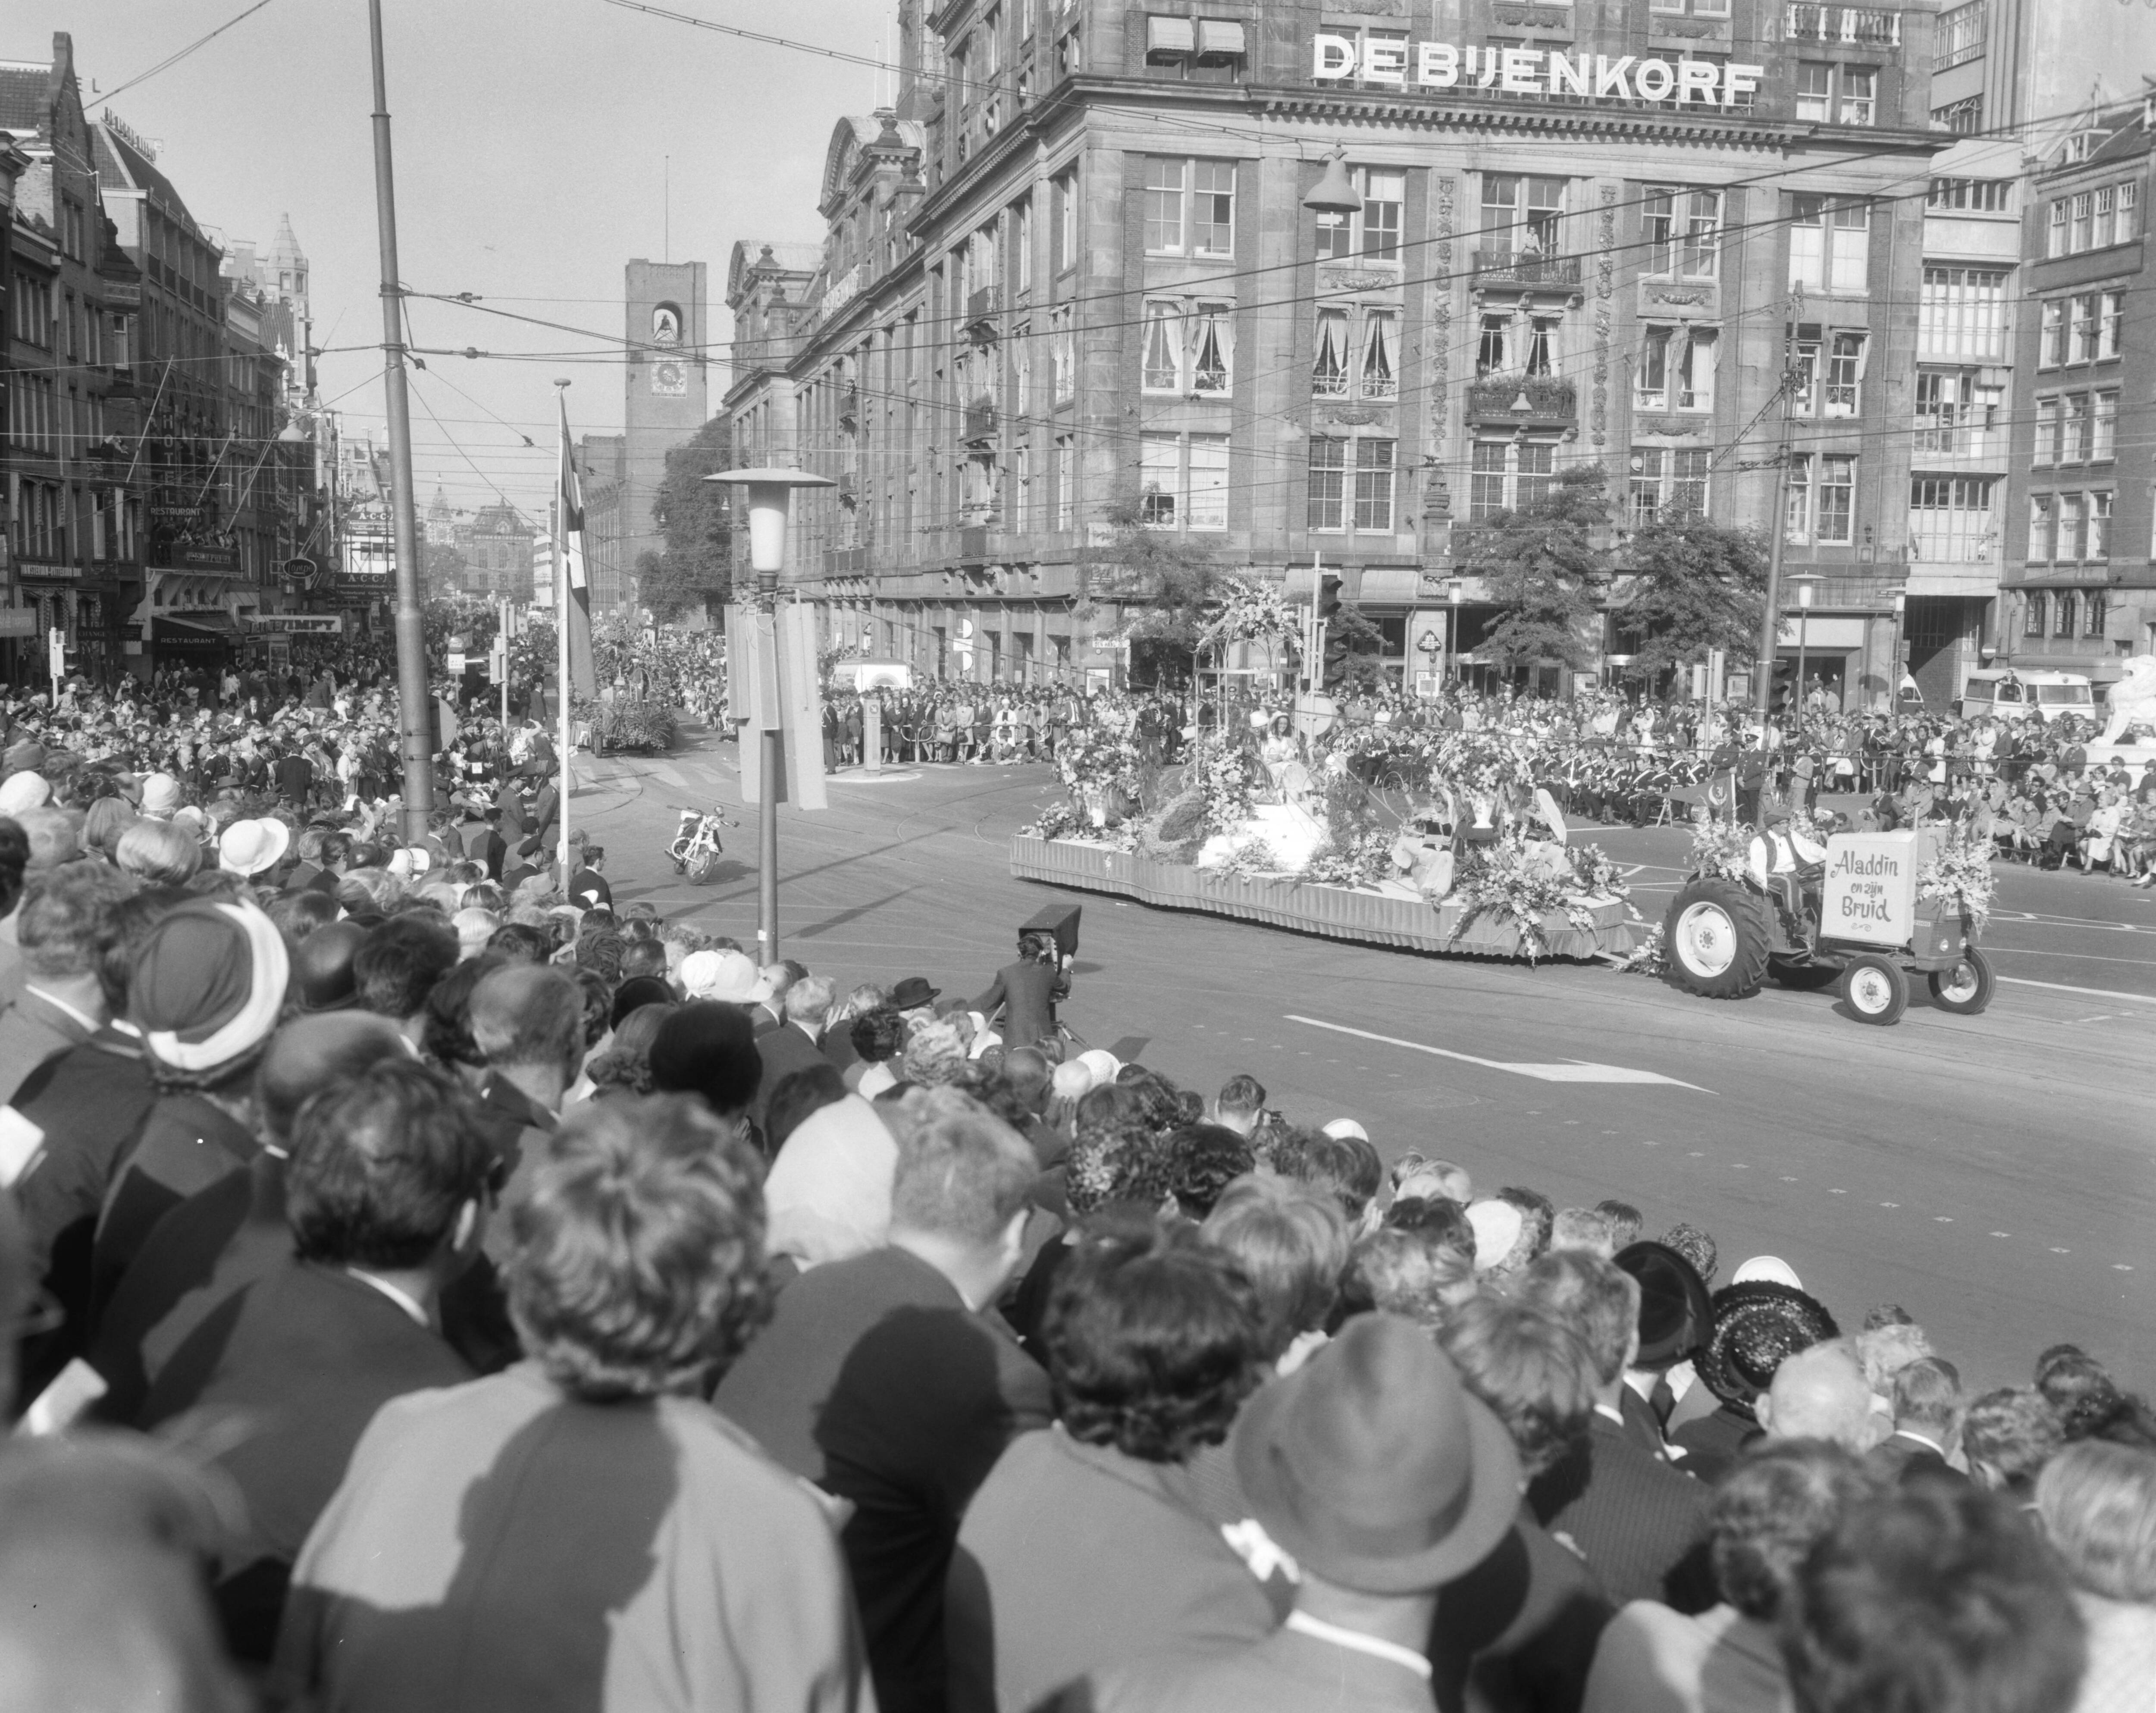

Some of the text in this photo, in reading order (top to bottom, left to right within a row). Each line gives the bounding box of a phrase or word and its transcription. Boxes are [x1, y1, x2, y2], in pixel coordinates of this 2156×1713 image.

[163, 415, 175, 504] HOTEL
[150, 507, 201, 516] RESTAURANT
[1830, 850, 1899, 878] Aladdin
[1851, 881, 1883, 899] en zijn
[1842, 896, 1892, 922] Bruid
